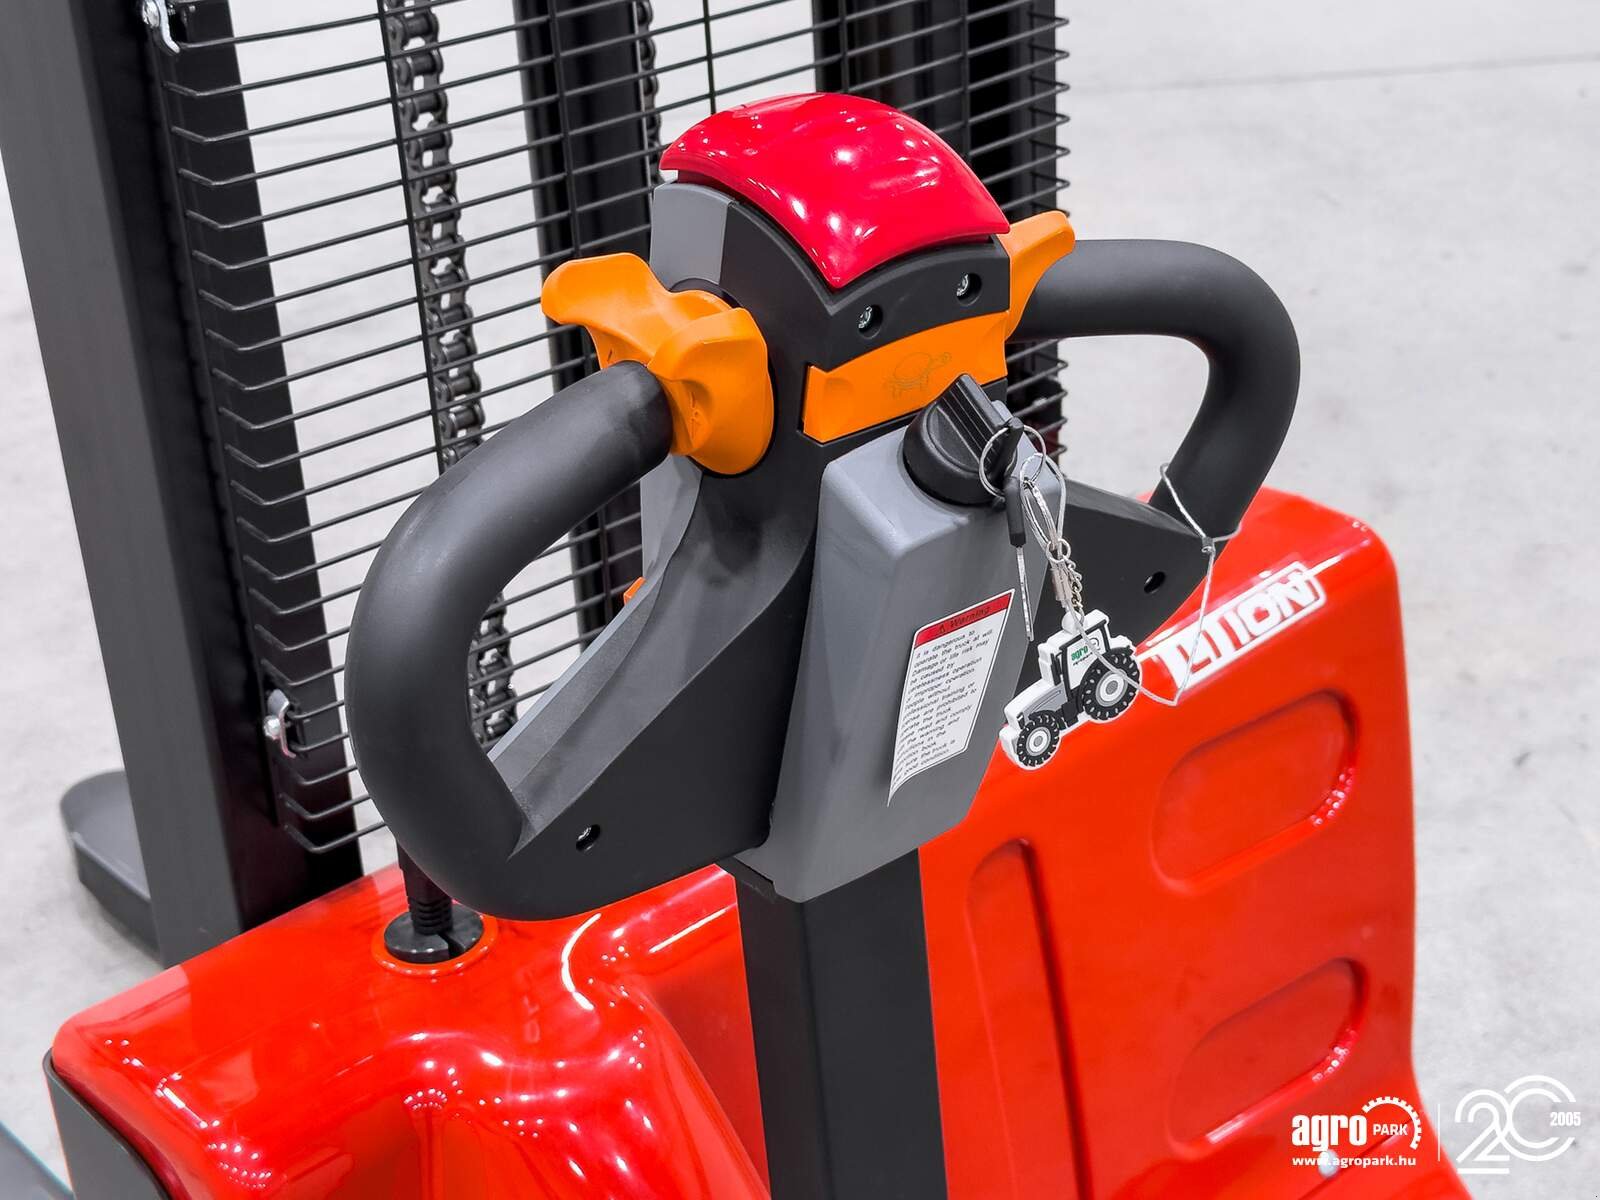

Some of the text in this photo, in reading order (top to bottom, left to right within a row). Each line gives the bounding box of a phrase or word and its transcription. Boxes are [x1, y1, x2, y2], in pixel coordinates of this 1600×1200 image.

[932, 634, 965, 652] dangerous
[954, 639, 970, 650] truck
[920, 665, 944, 680] caused
[952, 657, 982, 674] operation
[945, 668, 975, 684] operation
